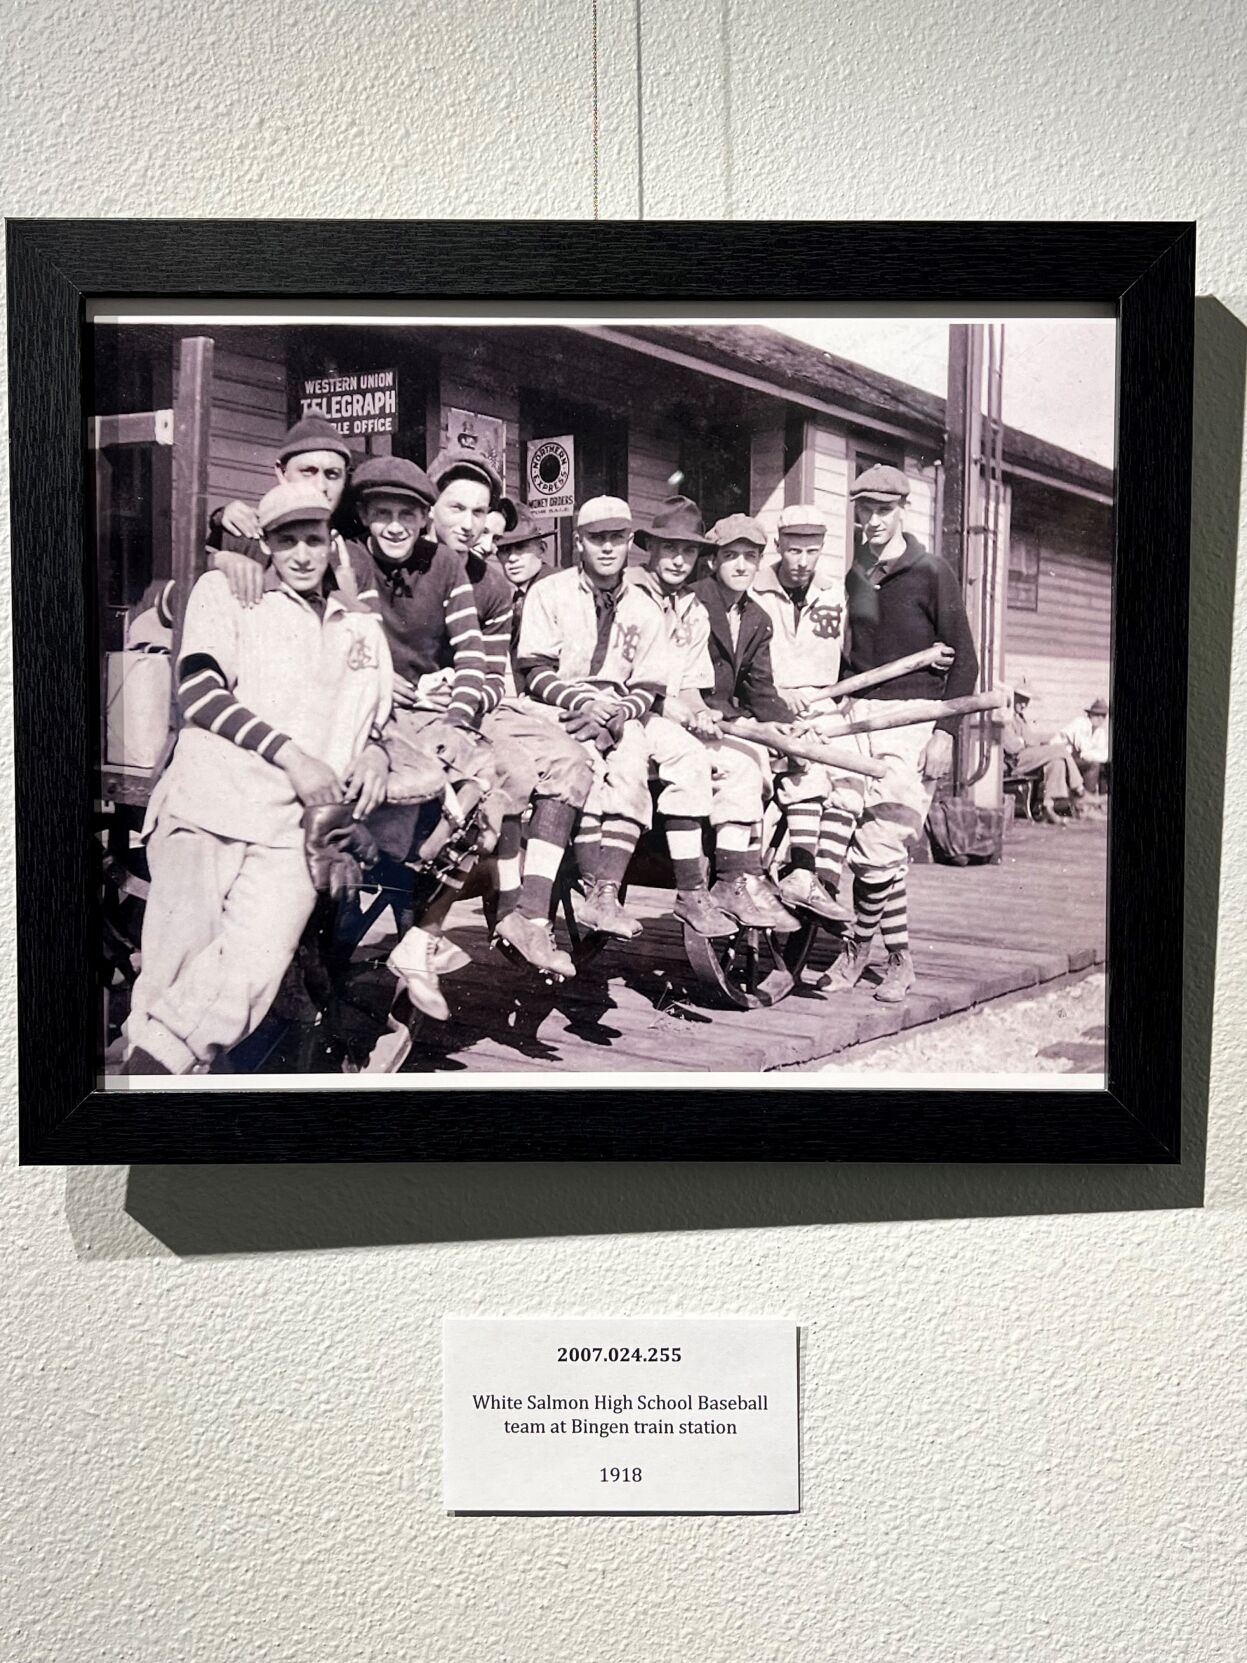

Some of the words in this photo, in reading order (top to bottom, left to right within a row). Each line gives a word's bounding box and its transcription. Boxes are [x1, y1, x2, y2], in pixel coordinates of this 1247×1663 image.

[304, 376, 357, 394] WESTERN
[360, 372, 393, 389] UNION
[300, 390, 396, 419] TELEGRAPH
[353, 417, 393, 433] OFFICE
[532, 445, 568, 469] NORTHERN
[532, 471, 568, 492] EXPRESS
[528, 498, 548, 508] MONEY
[549, 495, 574, 507] ORDERS
[557, 1347, 682, 1362] 2007.024.255
[472, 1394, 523, 1410] White
[527, 1394, 590, 1410] Salmon
[594, 1394, 633, 1414] High
[637, 1394, 693, 1410] School
[698, 1394, 768, 1411] Baseball
[504, 1420, 546, 1434] team
[550, 1420, 567, 1434] at
[571, 1419, 630, 1437] Bingen
[633, 1419, 675, 1434] train
[678, 1419, 737, 1435] station
[600, 1467, 642, 1483] 1918
